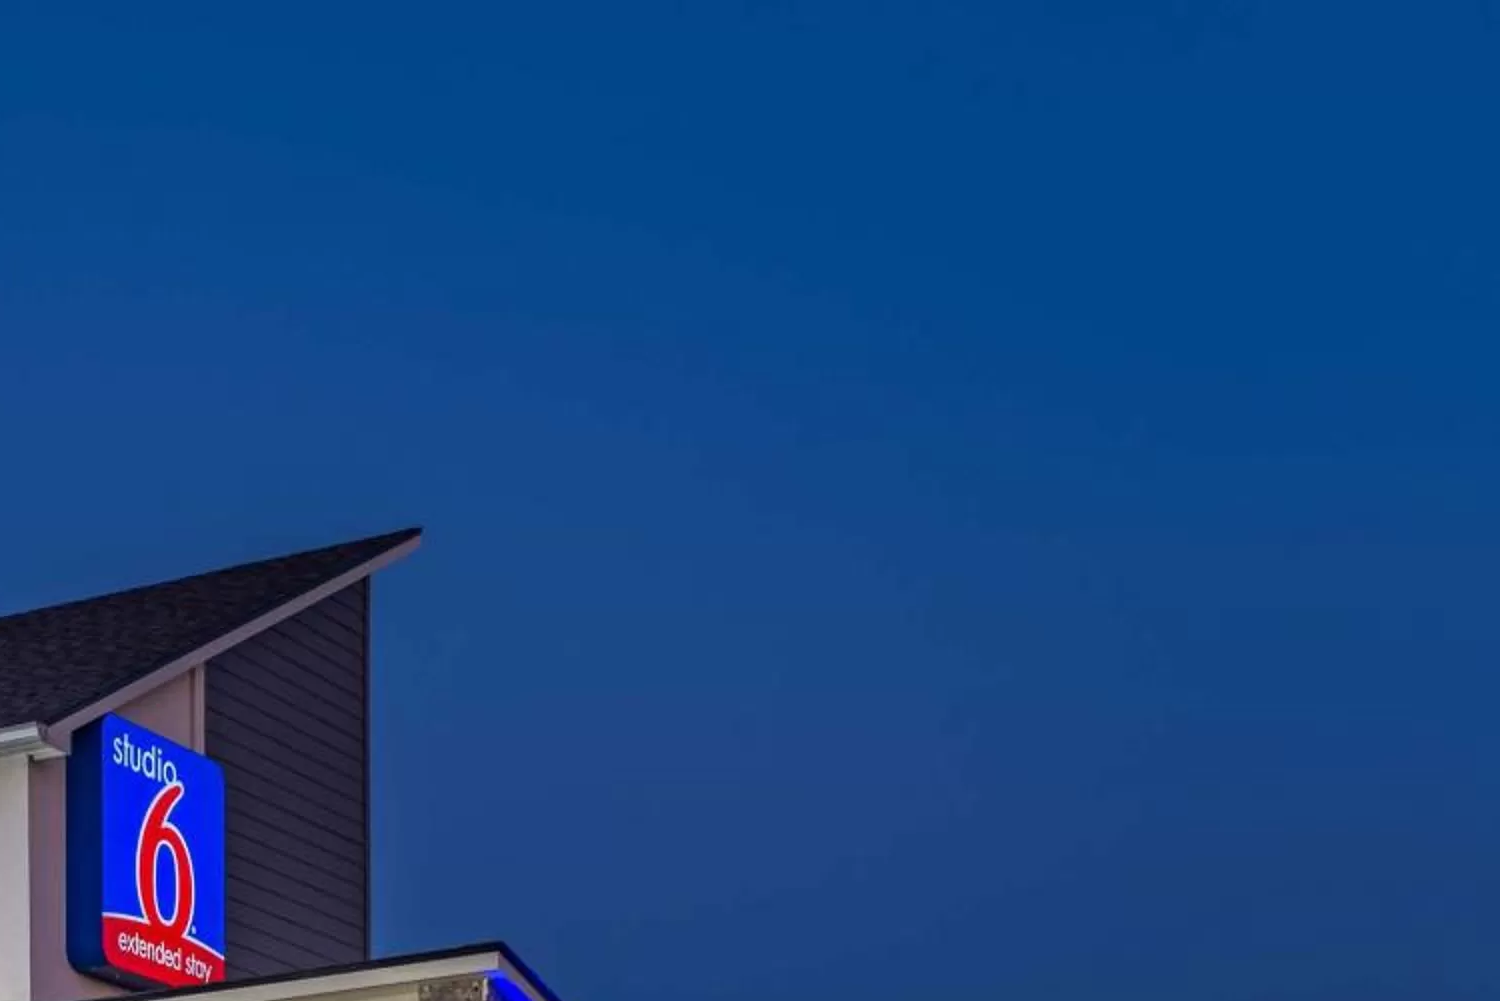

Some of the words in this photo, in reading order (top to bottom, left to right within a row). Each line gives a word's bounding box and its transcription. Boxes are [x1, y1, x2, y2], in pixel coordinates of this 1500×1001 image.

[113, 733, 177, 786] studio
[135, 782, 195, 938] 6
[117, 932, 182, 971] extended
[185, 952, 213, 984] stay
